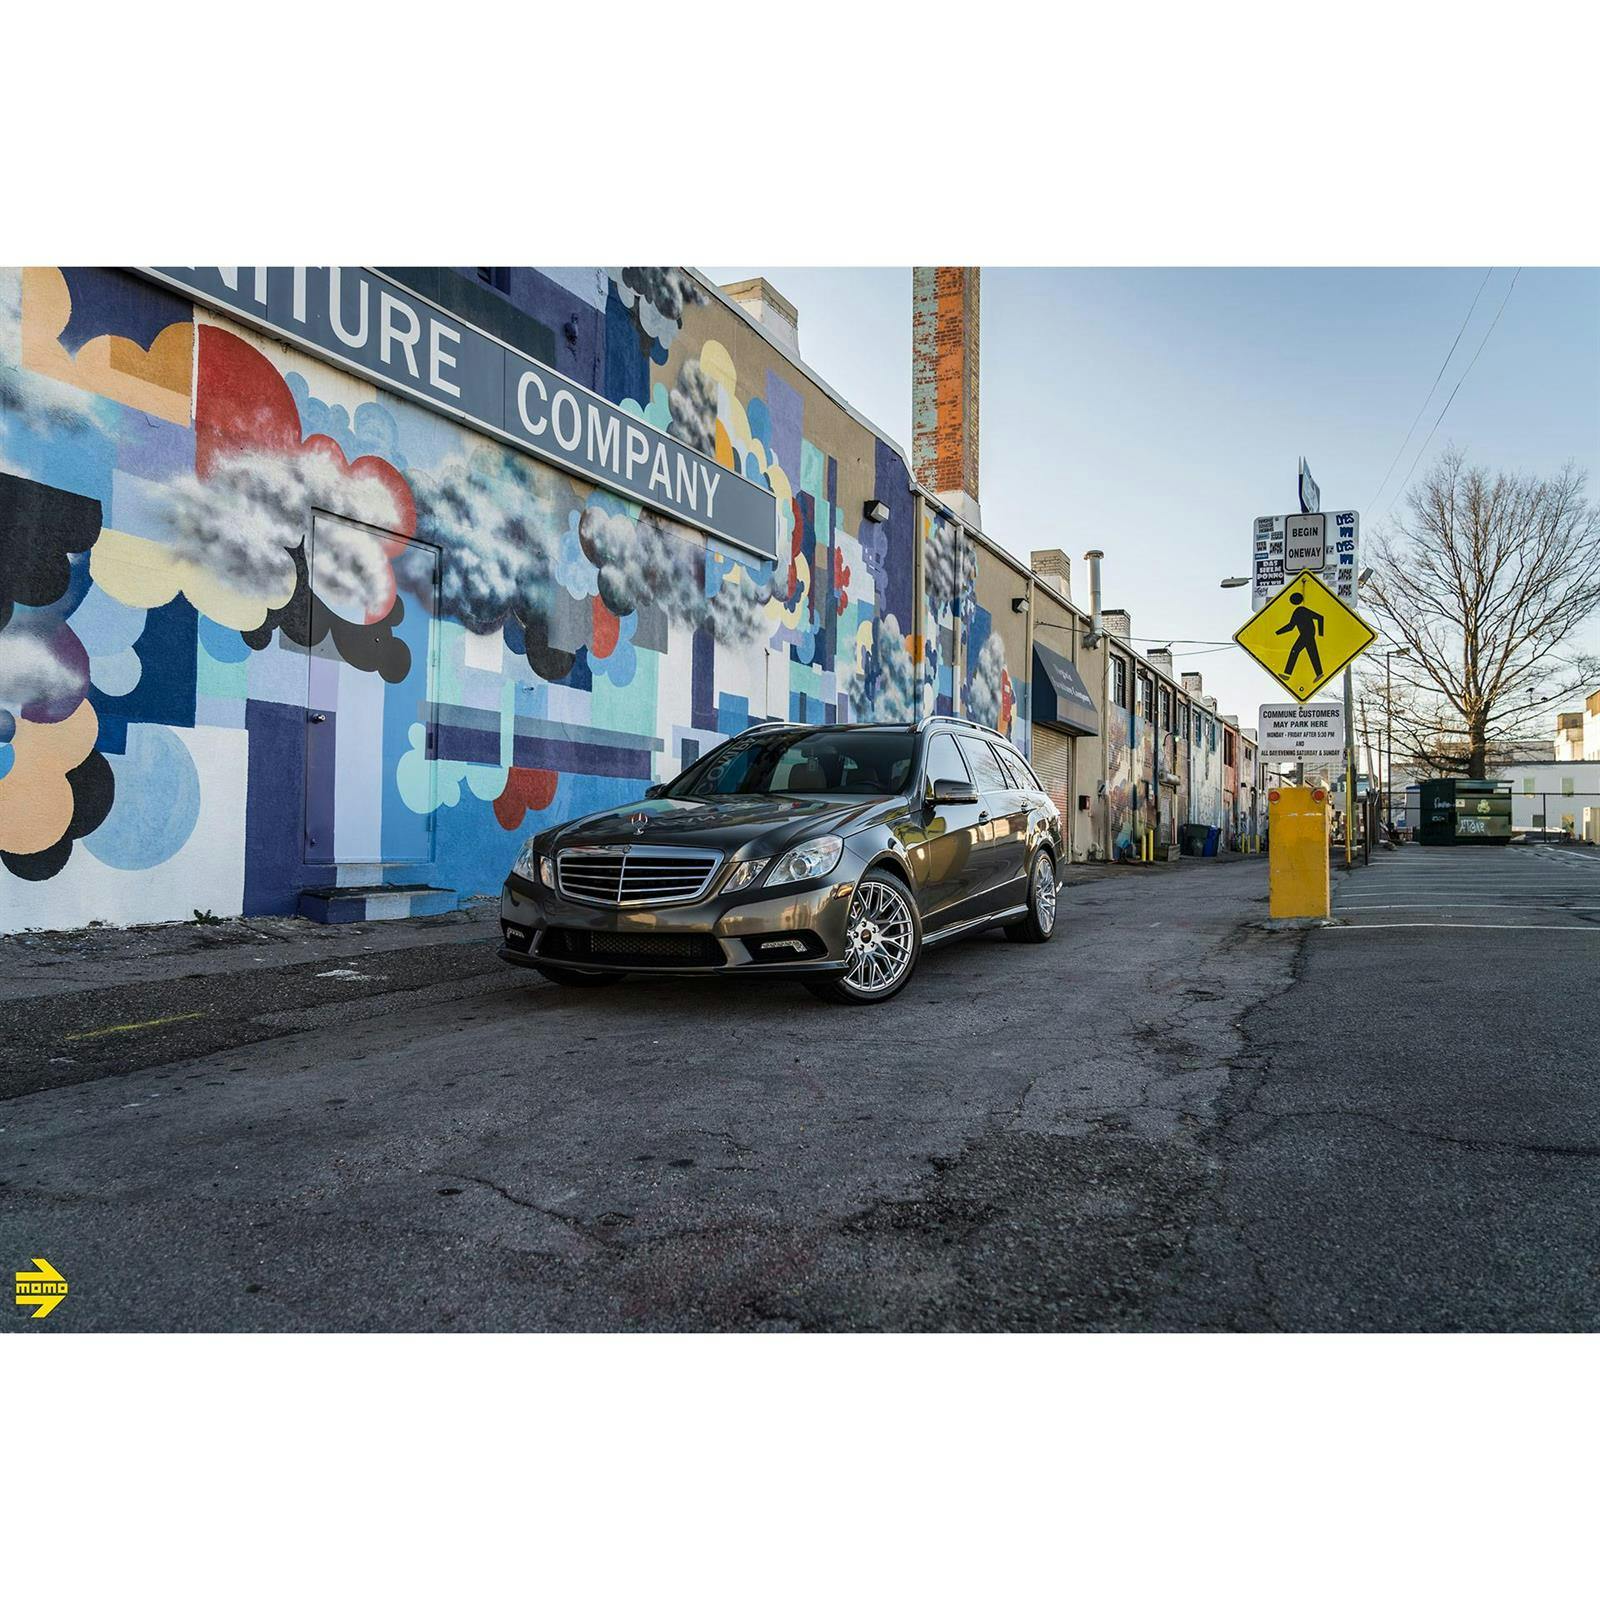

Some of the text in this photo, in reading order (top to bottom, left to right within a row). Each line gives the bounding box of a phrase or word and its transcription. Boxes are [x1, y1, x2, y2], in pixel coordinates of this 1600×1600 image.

[186, 267, 720, 519] TURE COMPANY
[1292, 527, 1319, 537] BEGIN
[1288, 547, 1321, 559] ONEWAY
[1263, 709, 1340, 719] COMMUNE CUSTOMERS
[1290, 720, 1308, 728] PARK
